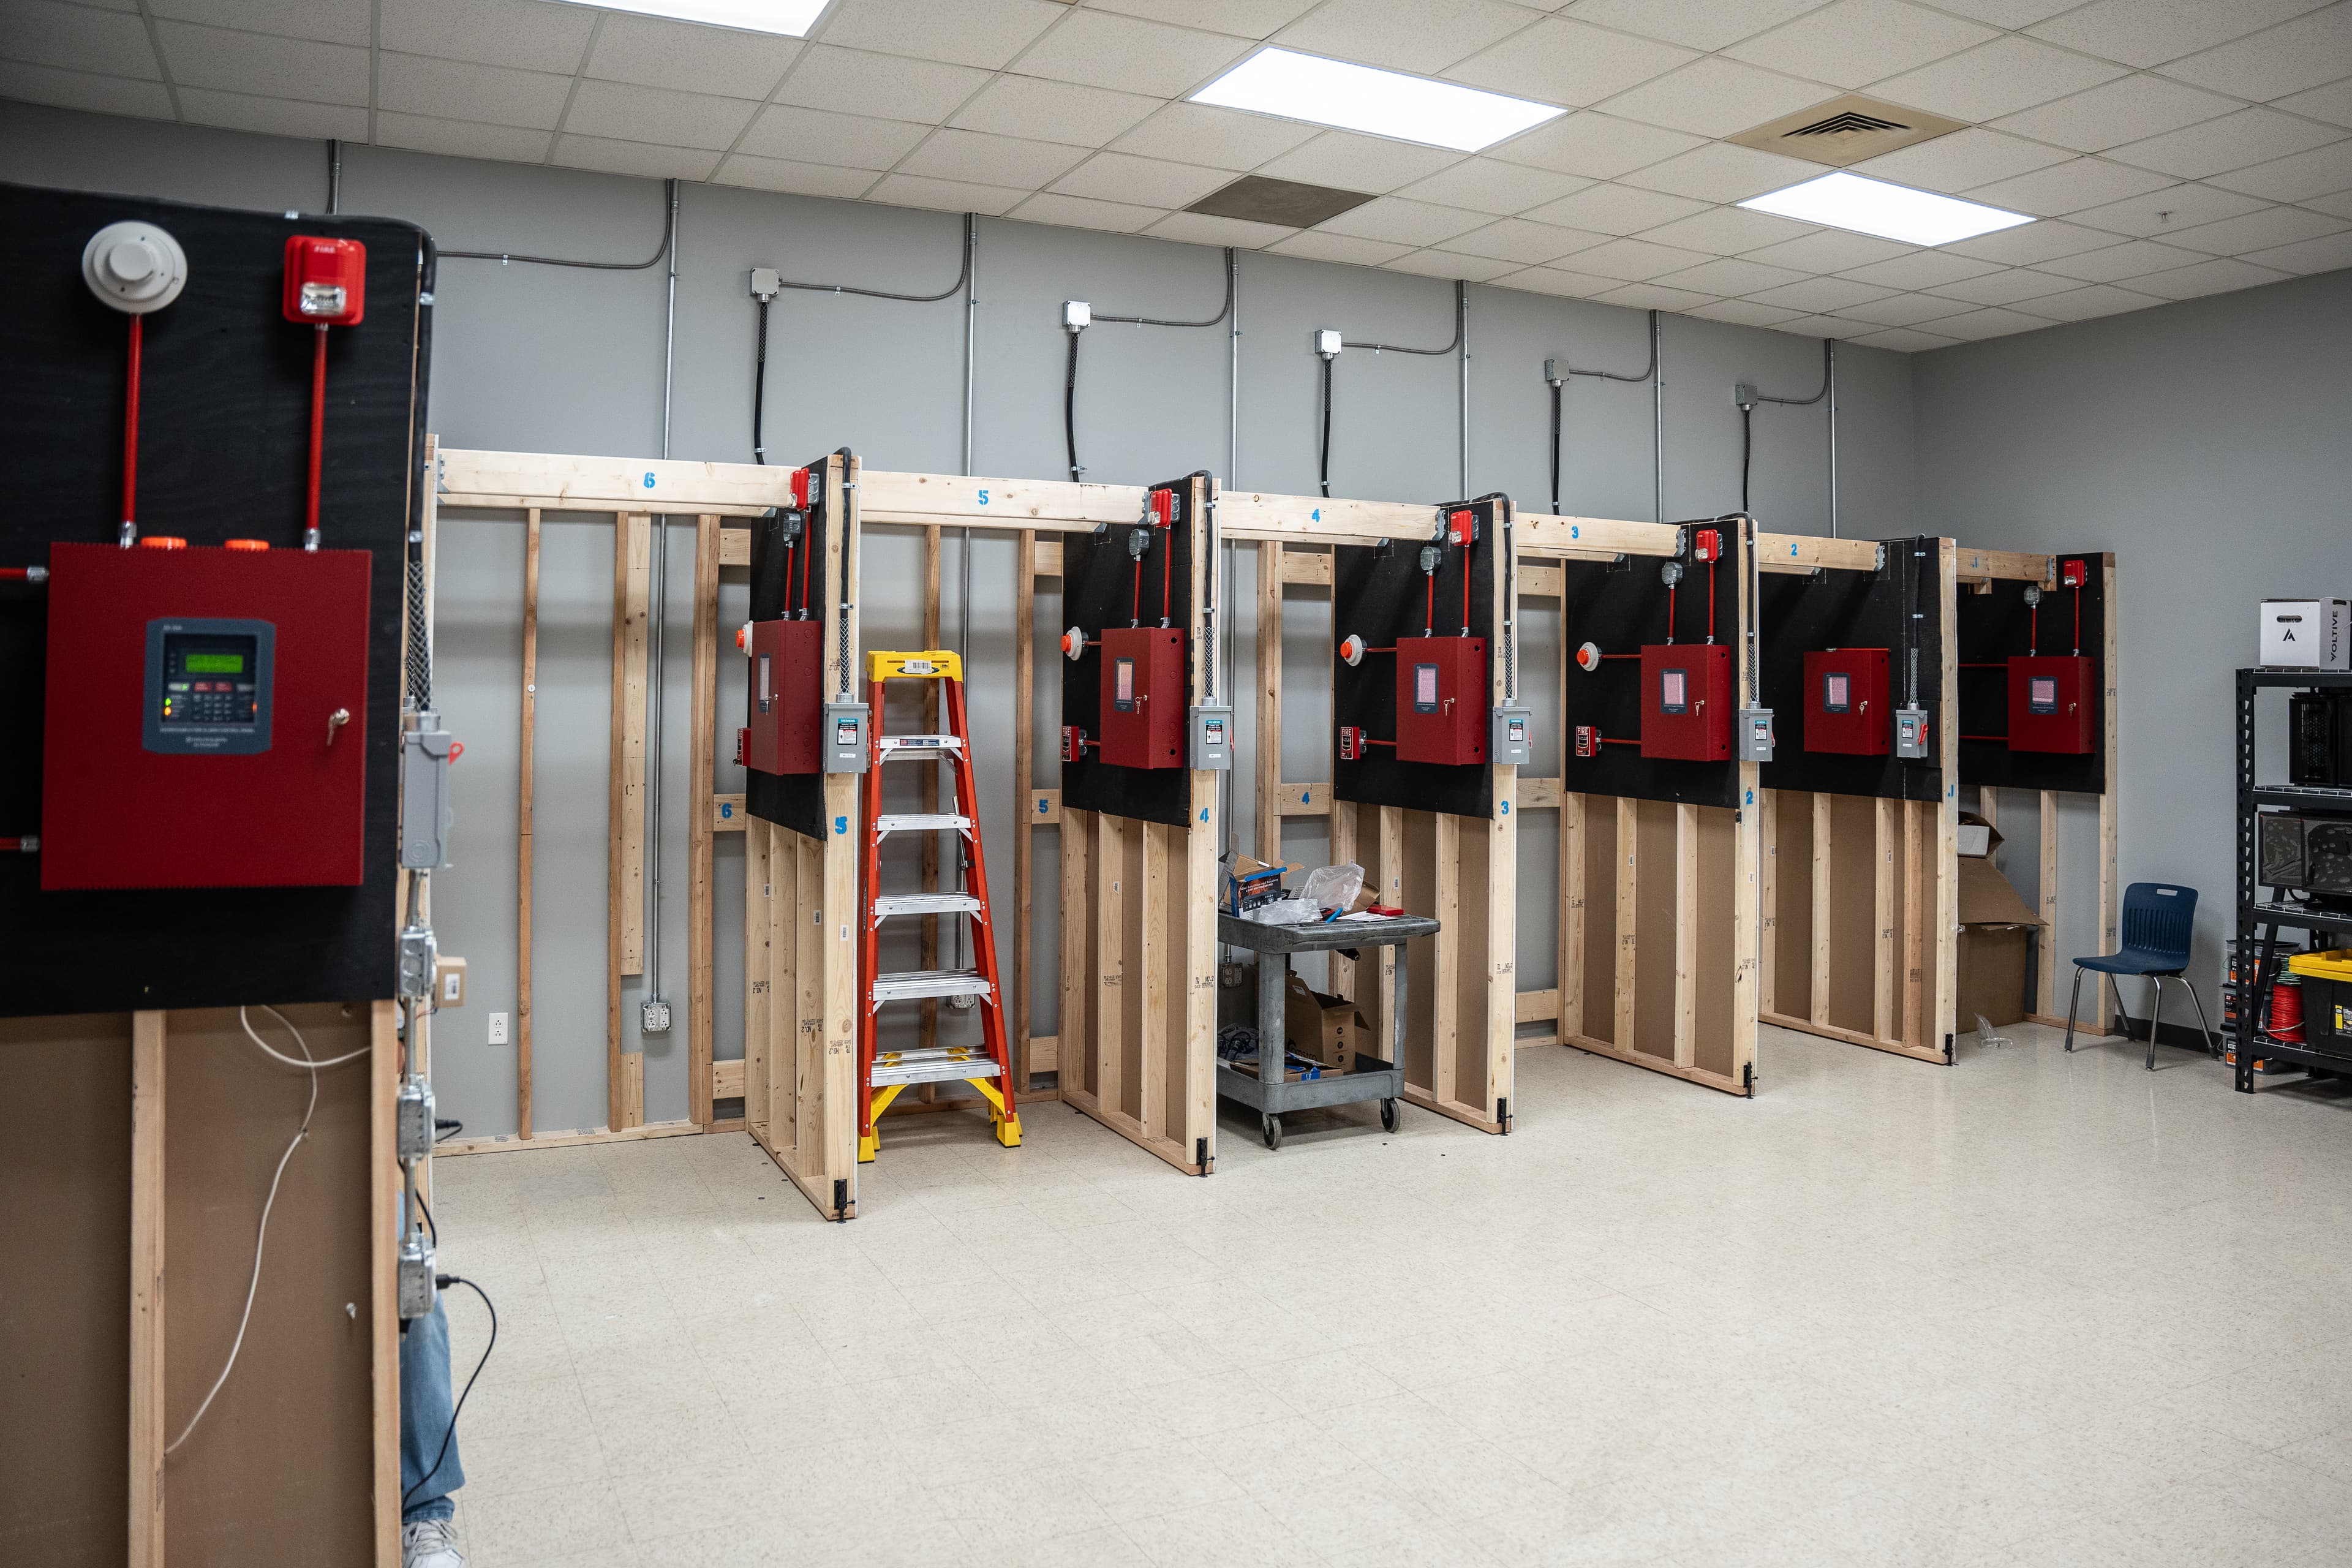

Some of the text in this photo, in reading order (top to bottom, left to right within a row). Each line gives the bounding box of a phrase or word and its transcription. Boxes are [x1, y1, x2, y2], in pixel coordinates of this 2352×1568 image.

[644, 472, 655, 488] 6
[978, 490, 989, 505] 5
[1312, 509, 1320, 522] 4
[1572, 526, 1579, 539] 3
[1791, 543, 1798, 556] 2
[1302, 792, 1310, 804] 4
[1746, 791, 1753, 804] 2
[722, 803, 732, 818] 6
[1039, 799, 1048, 813] 5
[1501, 801, 1509, 815] 3
[1200, 807, 1209, 823] 4
[835, 816, 848, 835] 5
